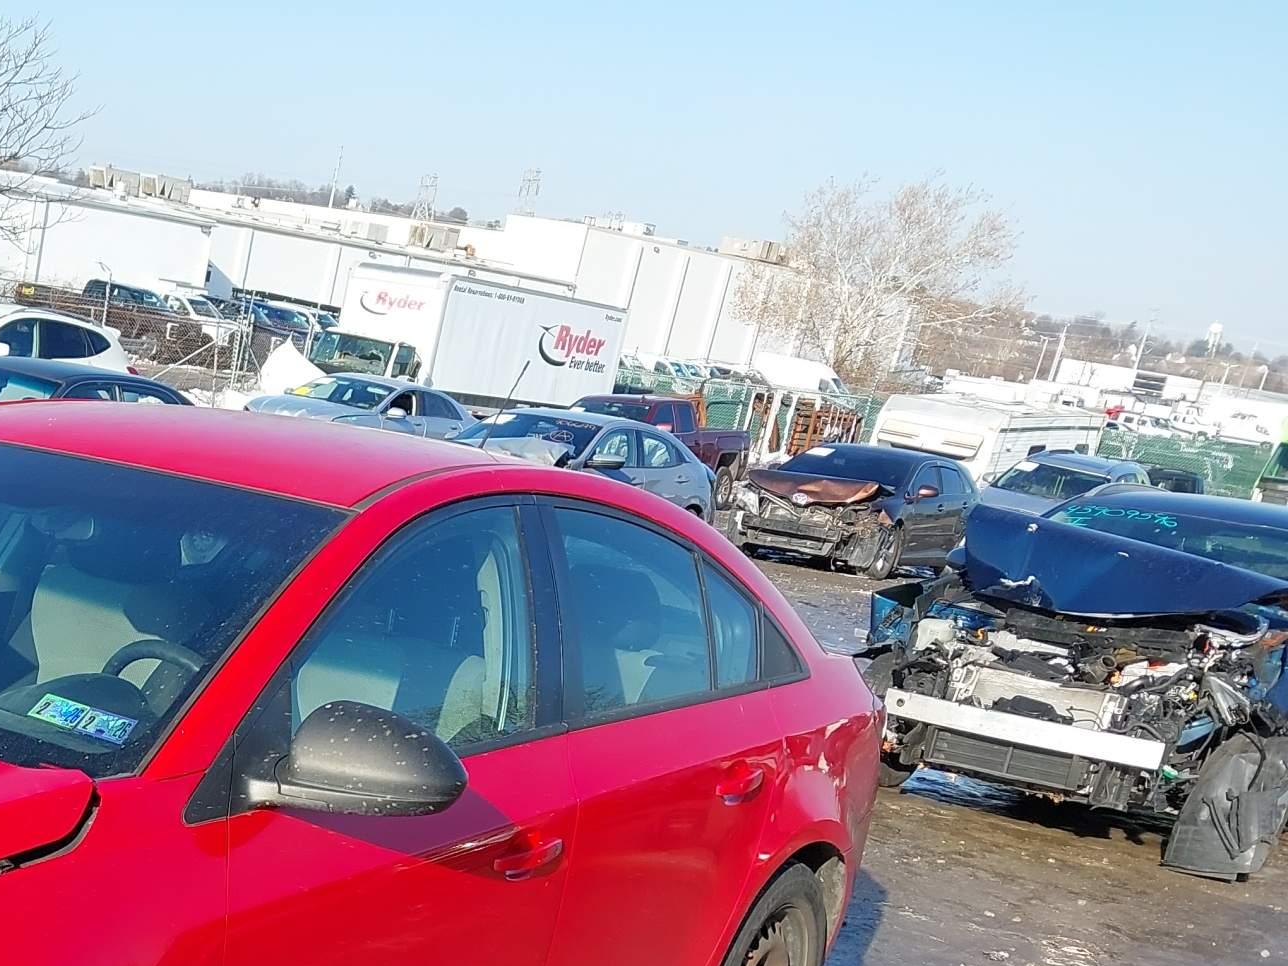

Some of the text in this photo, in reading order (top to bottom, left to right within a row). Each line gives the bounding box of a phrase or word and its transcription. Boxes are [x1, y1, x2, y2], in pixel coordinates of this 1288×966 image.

[375, 291, 426, 311] Ryder
[553, 324, 606, 358] Ryder
[568, 355, 585, 370] Ever
[36, 701, 51, 715] 2
[81, 715, 96, 730] 2
